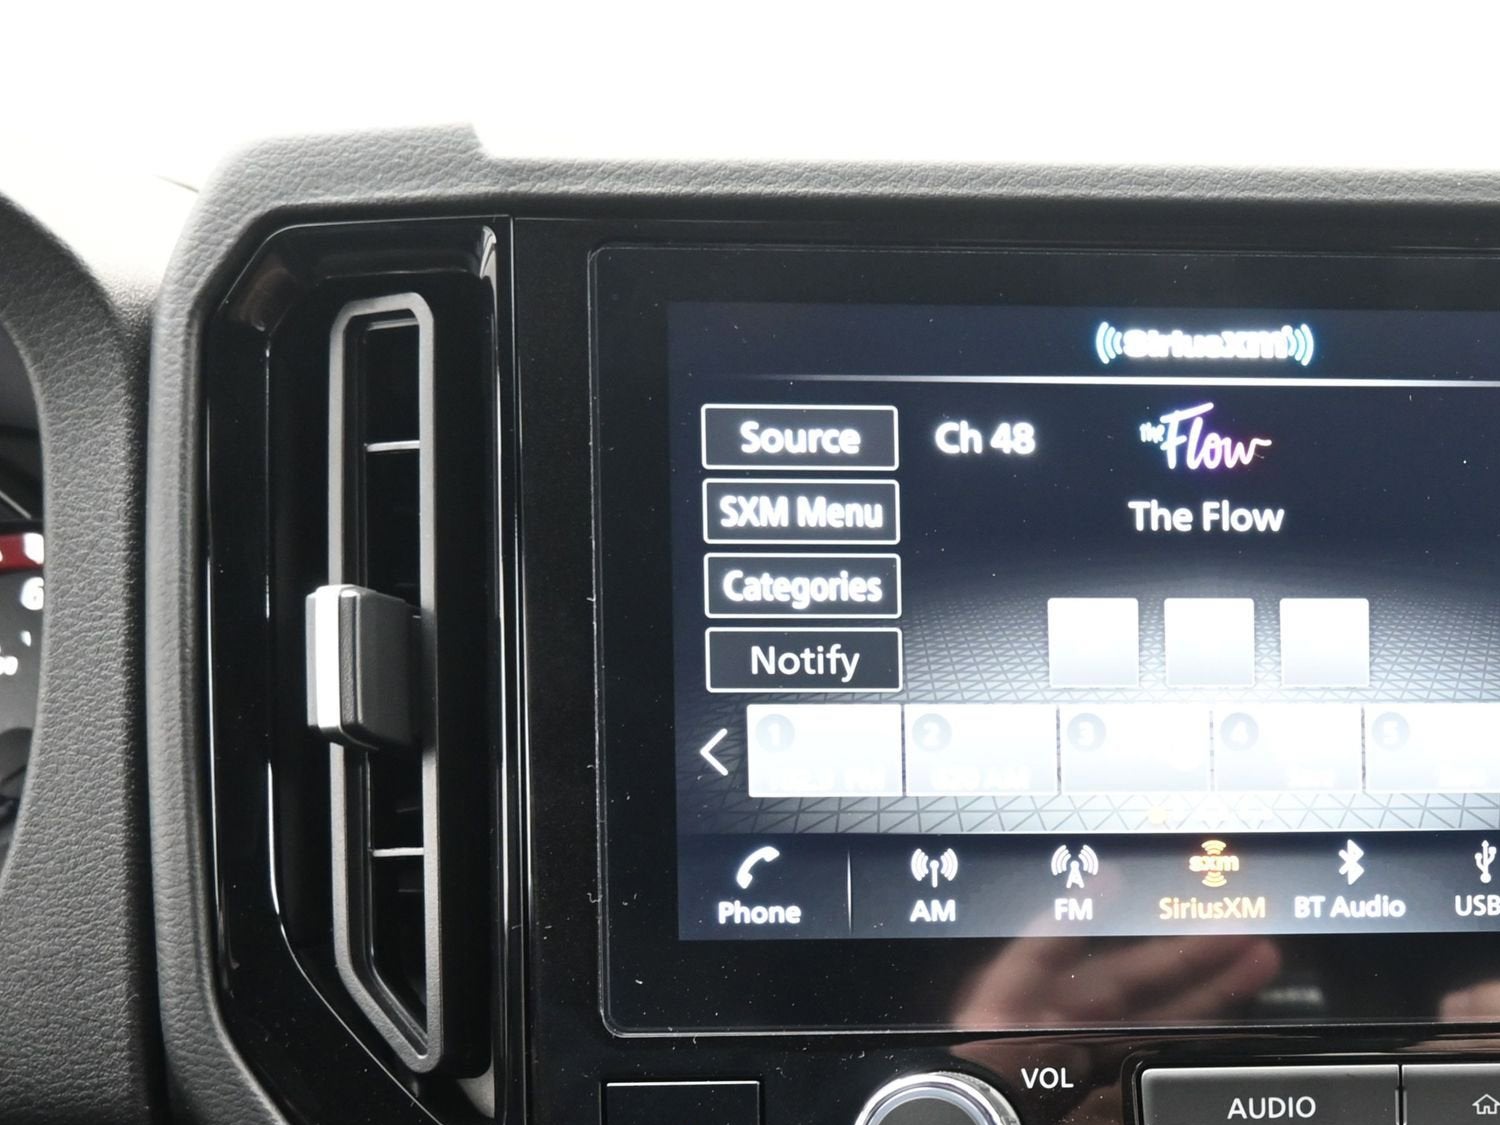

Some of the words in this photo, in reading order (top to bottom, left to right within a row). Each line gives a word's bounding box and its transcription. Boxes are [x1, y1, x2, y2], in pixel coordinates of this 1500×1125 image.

[739, 419, 862, 455] Source
[933, 419, 984, 455] Ch
[989, 421, 1037, 456] 48
[1160, 401, 1272, 469] Flow
[718, 494, 790, 529] SXM
[795, 495, 884, 529] Menu
[1127, 498, 1194, 533] The
[1201, 499, 1285, 533] Flow
[721, 569, 884, 610] Categories
[750, 643, 861, 683] Notify
[717, 899, 802, 925] Phone
[909, 898, 957, 923] AM
[1054, 897, 1094, 921] FM
[1157, 894, 1267, 920] SiriusXM
[1293, 895, 1327, 919] BT
[1329, 893, 1407, 919] Audio
[1020, 1067, 1075, 1089] VOL
[1227, 1095, 1316, 1120] AUDIO
